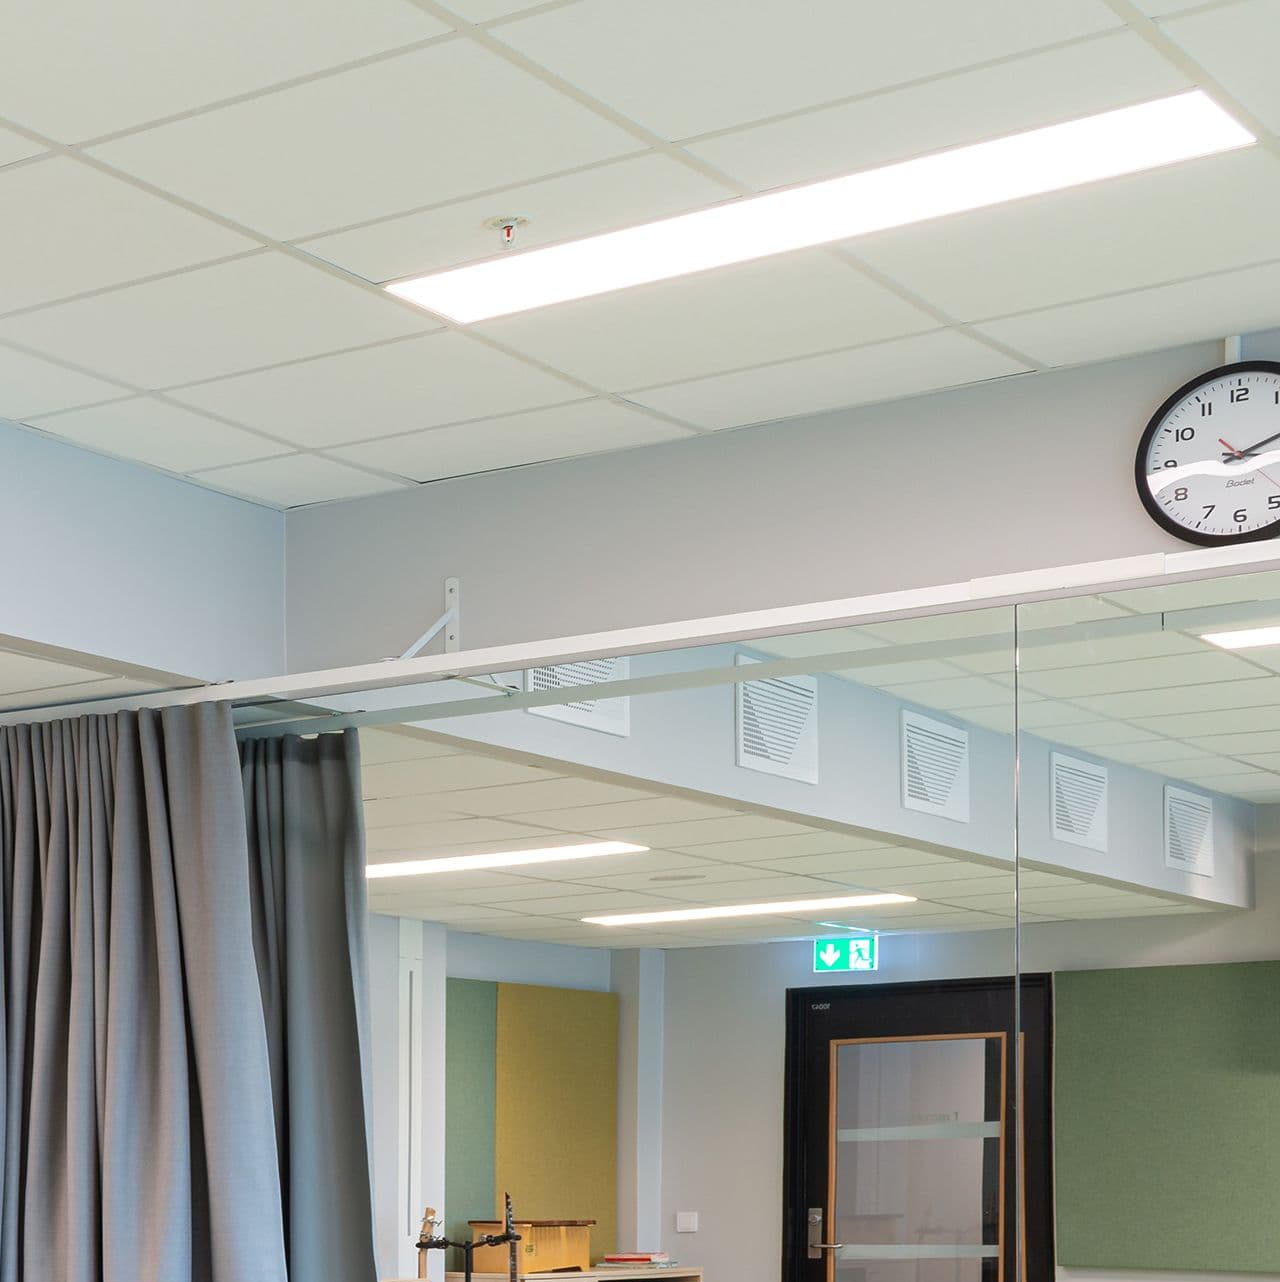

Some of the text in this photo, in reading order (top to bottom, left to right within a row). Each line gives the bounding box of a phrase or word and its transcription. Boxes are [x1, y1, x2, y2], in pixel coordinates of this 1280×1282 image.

[1230, 387, 1249, 403] 12
[1201, 402, 1212, 416] 11
[1175, 427, 1195, 442] 10
[1225, 478, 1255, 488] Bodet
[1174, 487, 1188, 501] 8
[1268, 496, 1280, 510] 5
[1203, 505, 1216, 519] 7
[1233, 509, 1247, 523] 6
